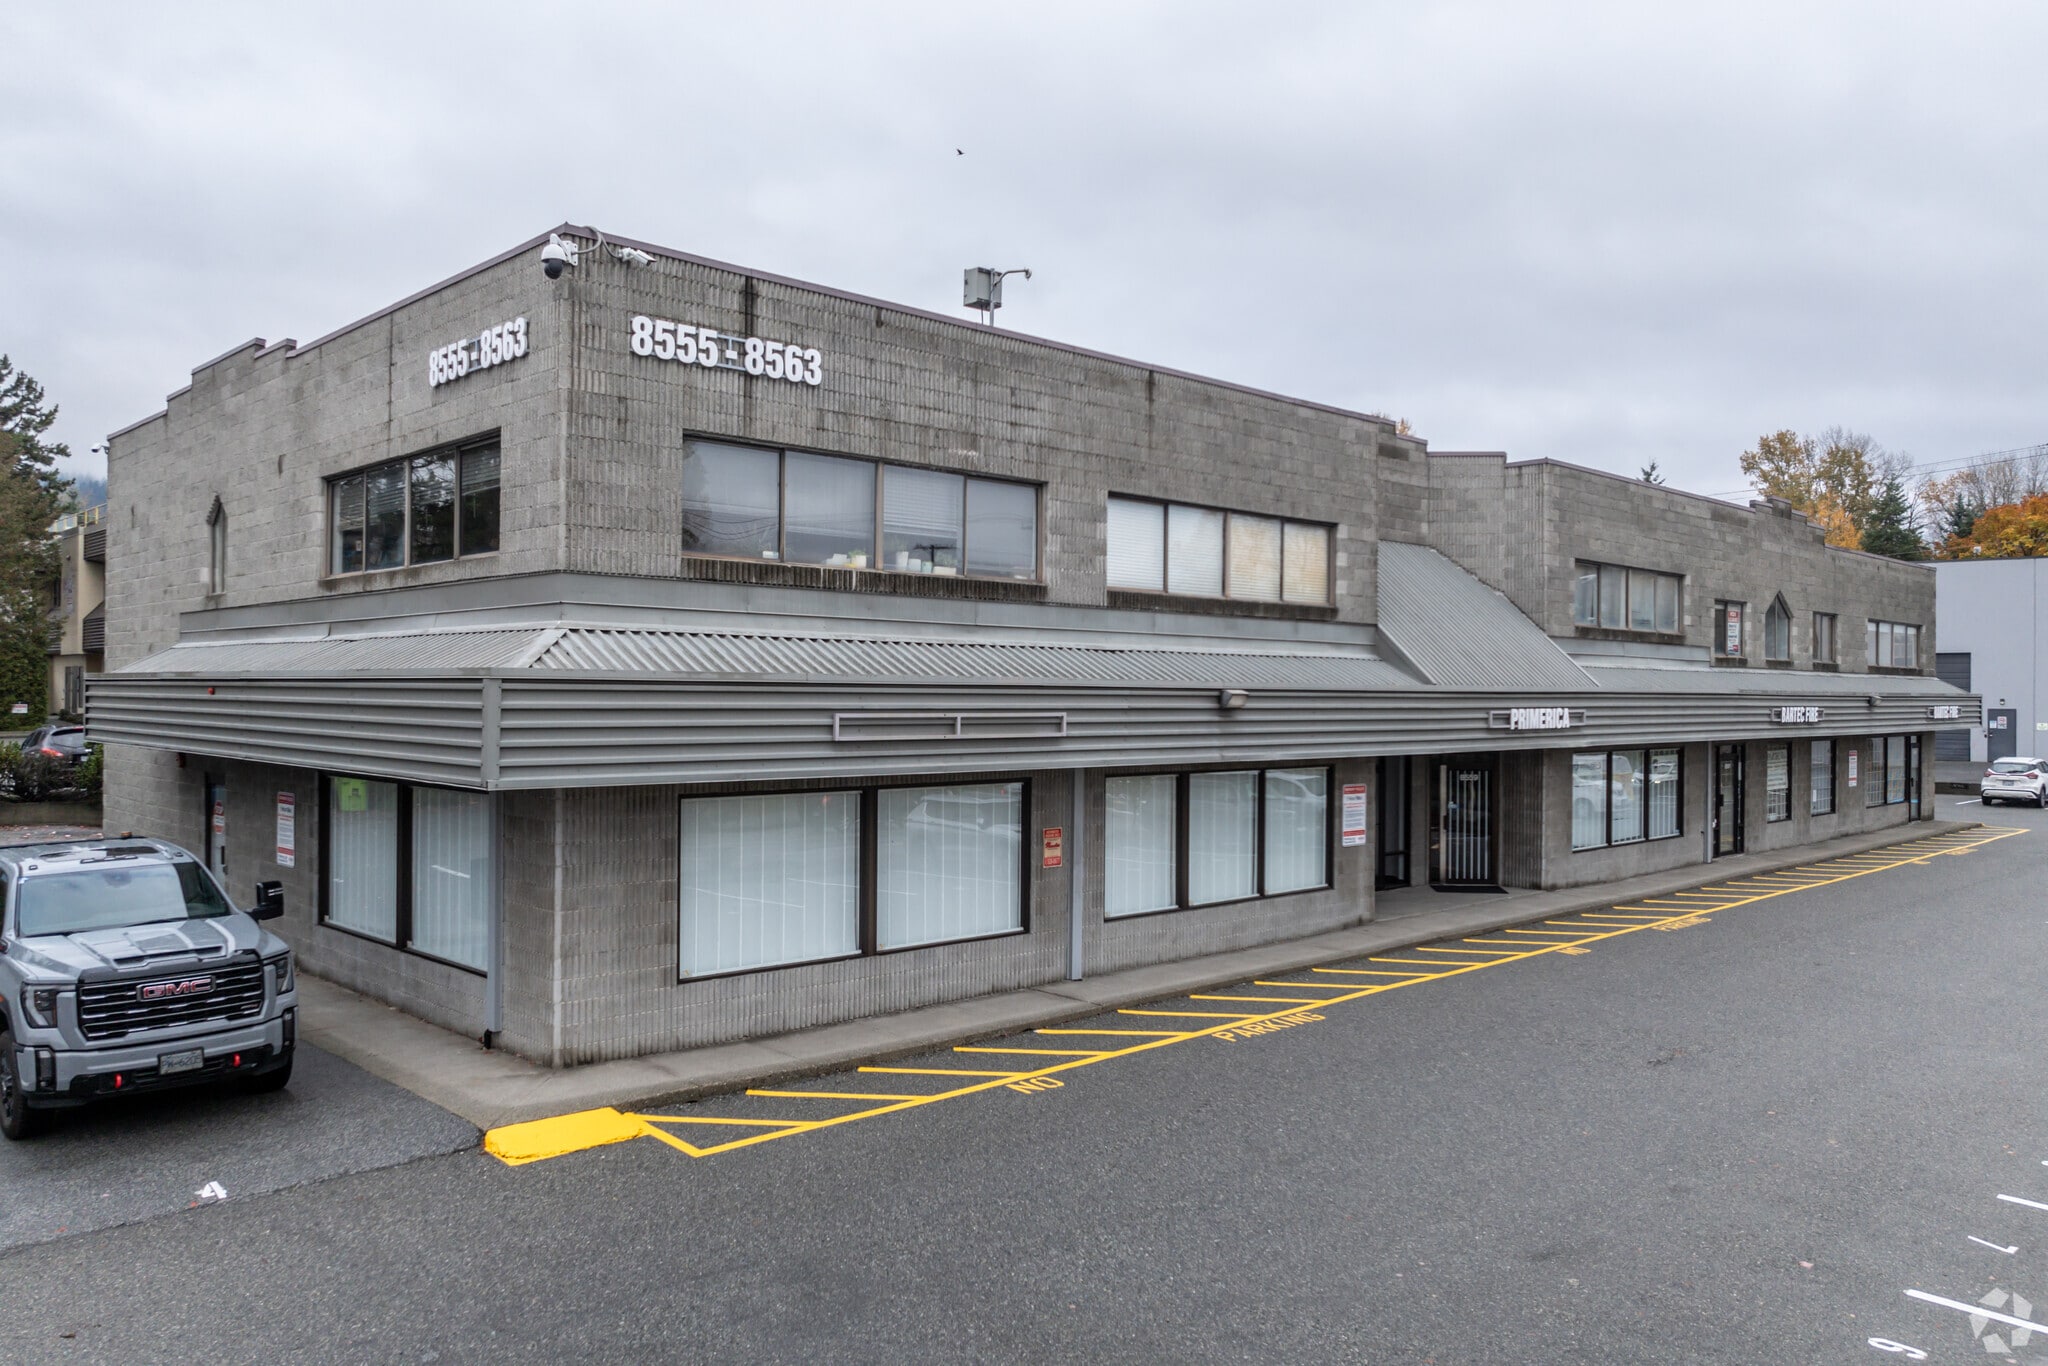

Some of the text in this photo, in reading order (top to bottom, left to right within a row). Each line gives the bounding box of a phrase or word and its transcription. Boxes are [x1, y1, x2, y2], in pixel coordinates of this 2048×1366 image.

[429, 338, 470, 387] 8555
[480, 317, 528, 369] 8563
[631, 315, 719, 368] 8555
[744, 337, 823, 386] 8563
[1510, 707, 1571, 730] PRIMERICA
[1781, 706, 1819, 723] BARTEC FIRE
[143, 978, 211, 999] GMC
[1006, 1011, 1327, 1094] NO PARKING
